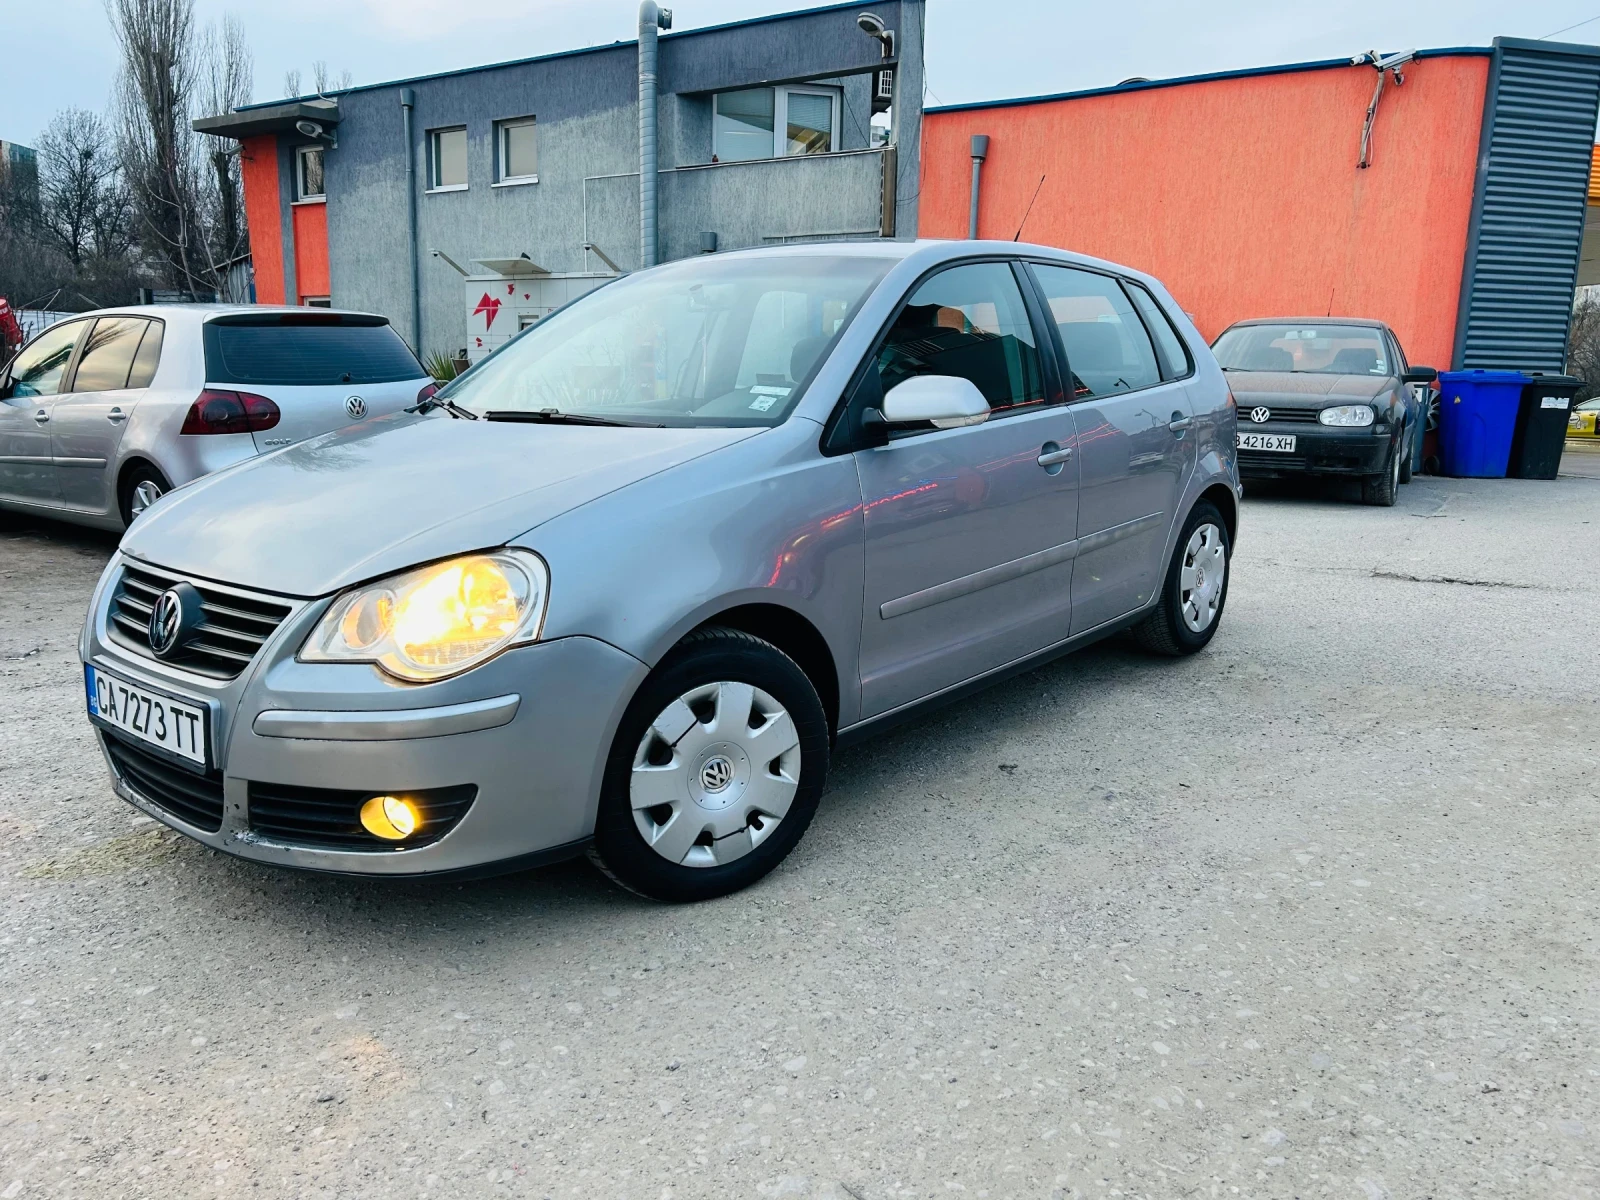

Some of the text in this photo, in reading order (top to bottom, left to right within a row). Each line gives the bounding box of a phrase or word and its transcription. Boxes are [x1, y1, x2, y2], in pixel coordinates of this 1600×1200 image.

[1251, 406, 1270, 423] VW
[1243, 436, 1273, 449] 4216
[1276, 438, 1293, 450] XH
